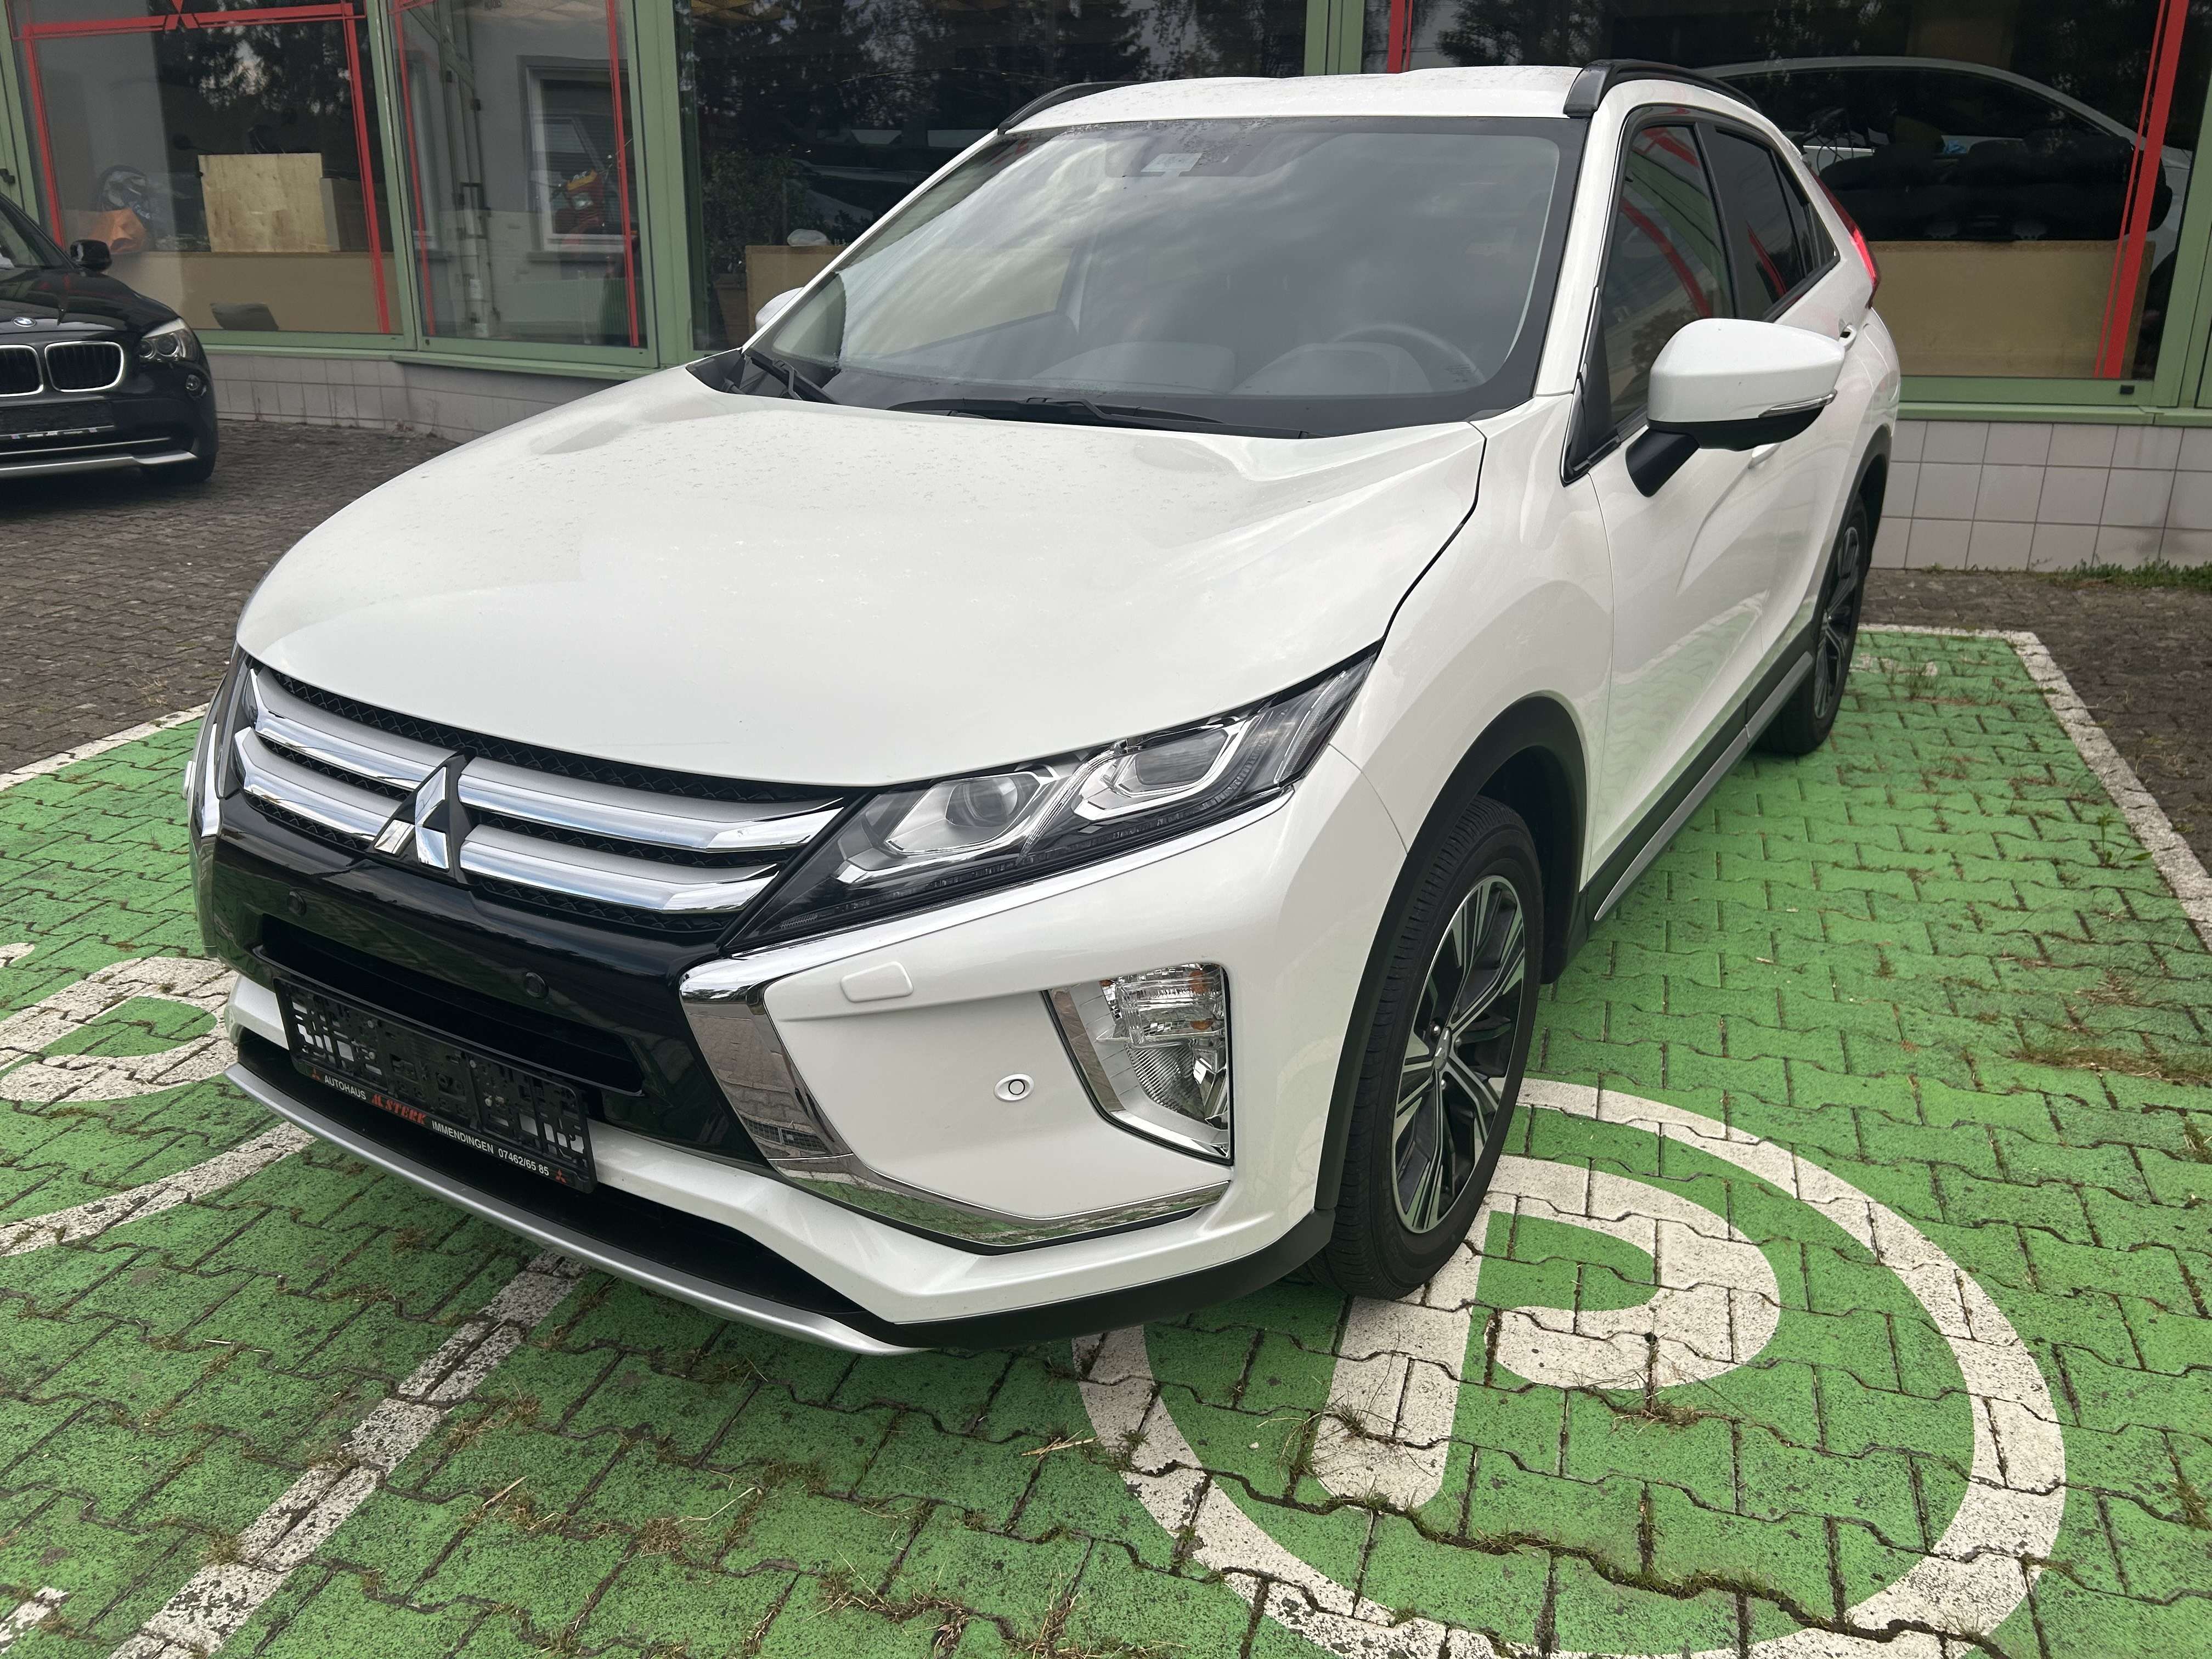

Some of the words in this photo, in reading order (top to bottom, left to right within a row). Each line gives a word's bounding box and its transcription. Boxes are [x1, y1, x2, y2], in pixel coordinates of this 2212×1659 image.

[324, 1075, 366, 1100] AUTOHAUS
[385, 1099, 427, 1125] STERK
[431, 1120, 494, 1154] IMMENDINGEN
[498, 1148, 537, 1171] 07462/65
[538, 1164, 550, 1176] 85
[1311, 1154, 1780, 1513] P
